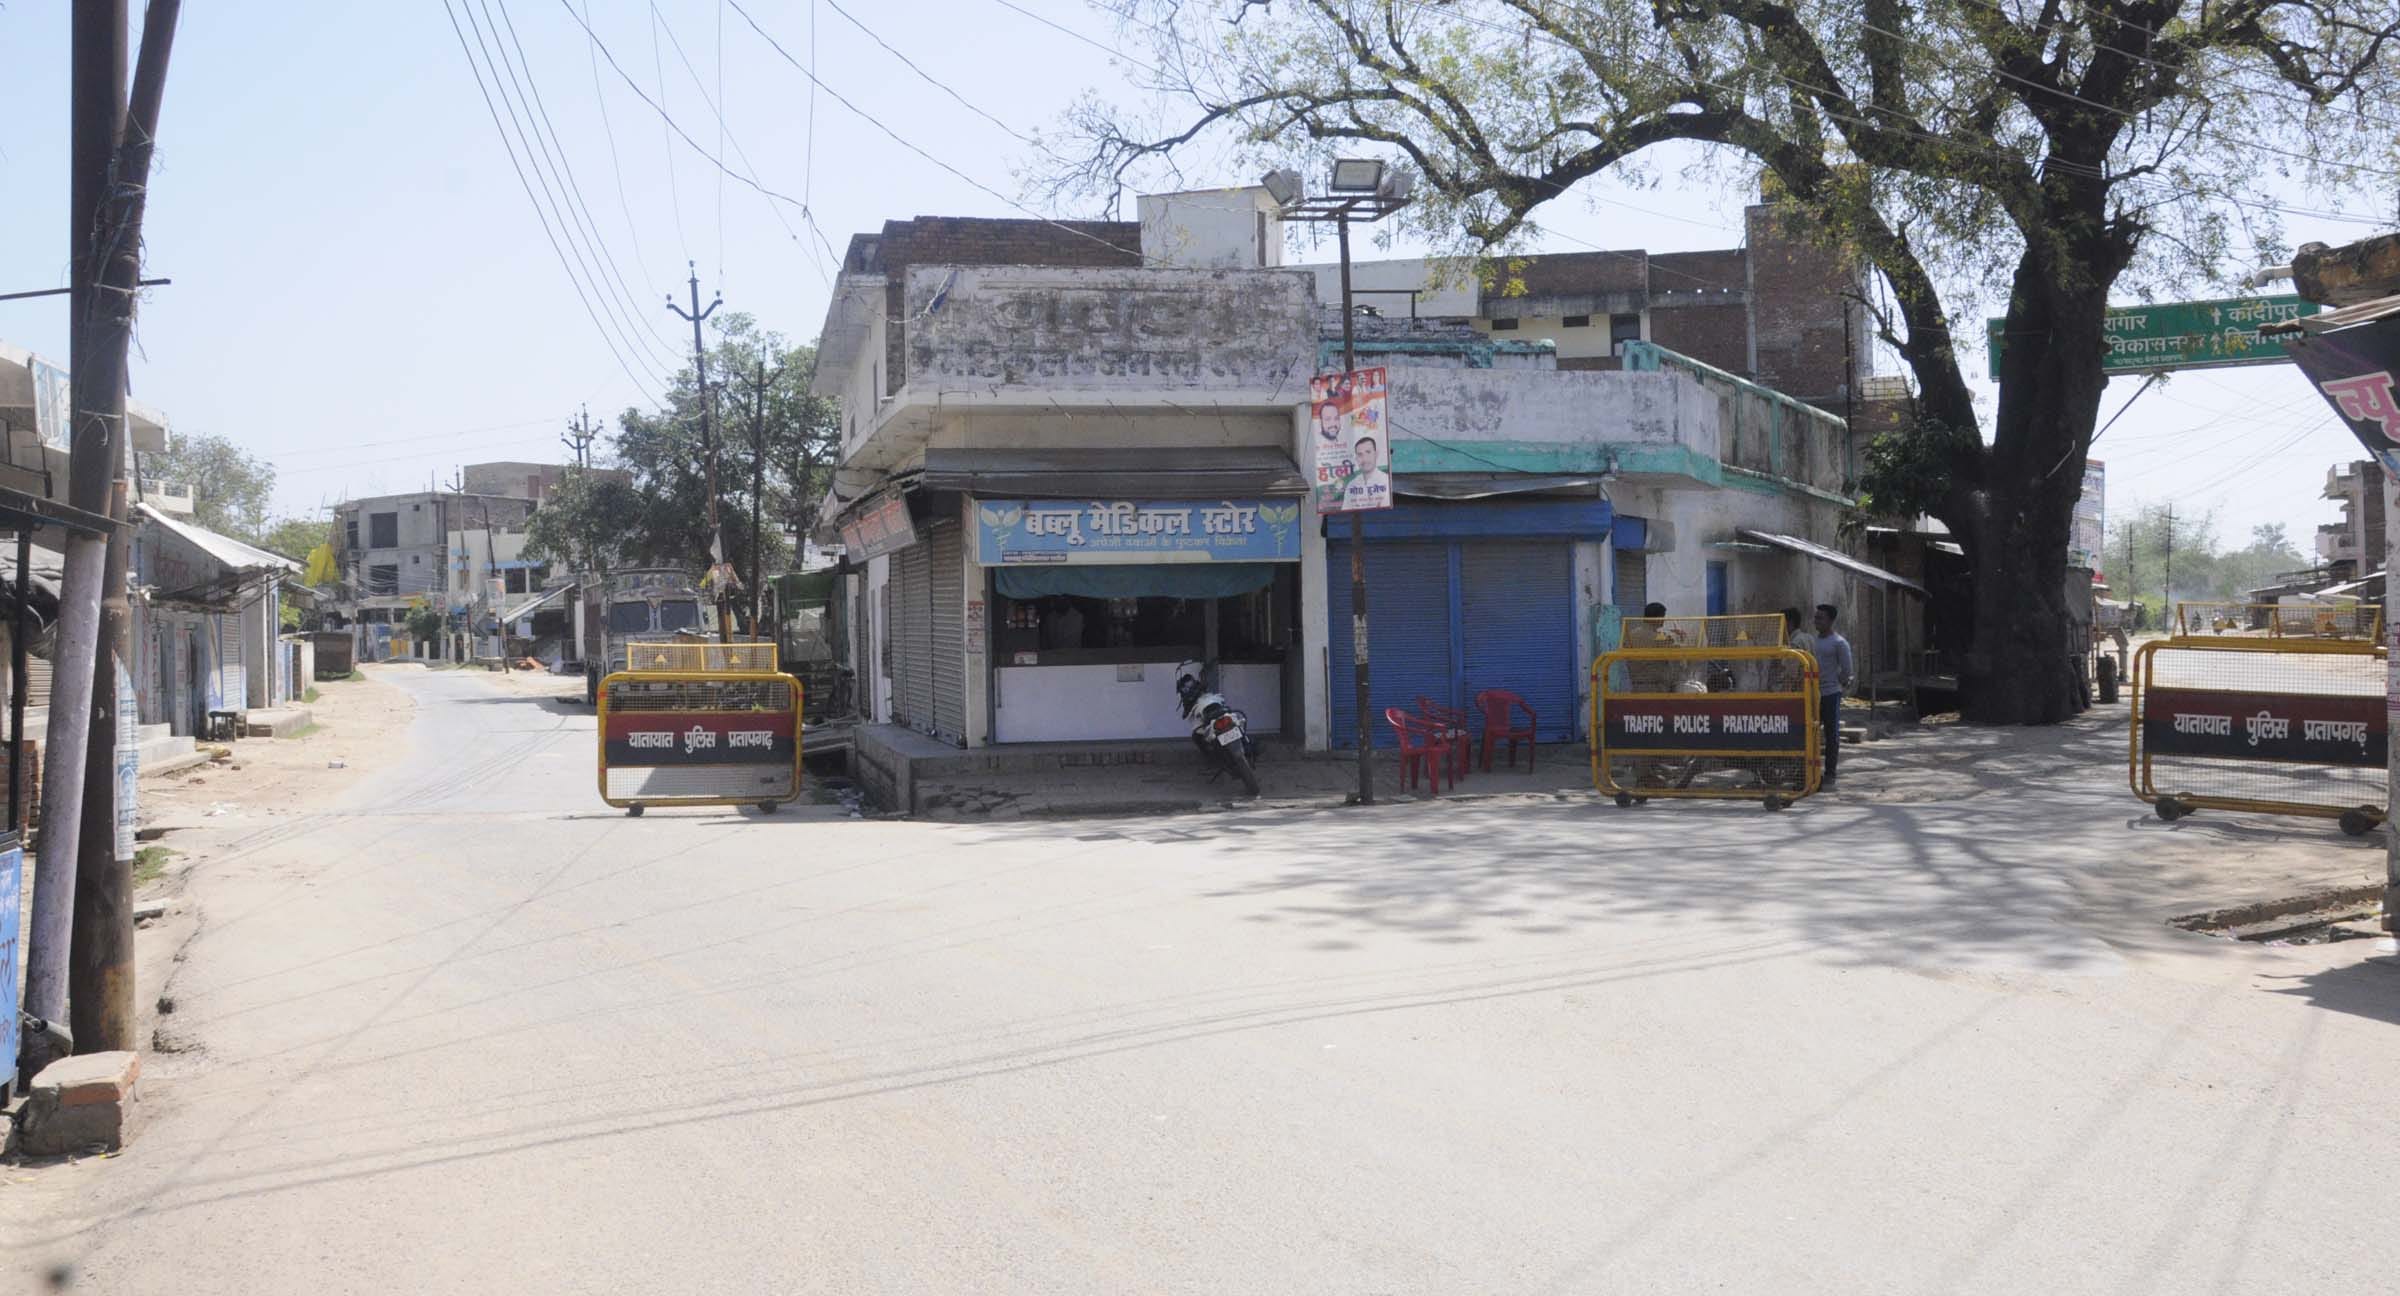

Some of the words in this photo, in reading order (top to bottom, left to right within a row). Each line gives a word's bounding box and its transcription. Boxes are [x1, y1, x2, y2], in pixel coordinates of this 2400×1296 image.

[1025, 507, 1086, 546] बब्लू
[1087, 501, 1193, 536] मेडिकल
[1199, 501, 1258, 535] स्टोर
[628, 731, 674, 748] यातायात
[684, 725, 717, 754] पुलिस
[728, 730, 774, 750] प्रतापगढ़
[1624, 715, 1664, 733] TRAFFIC
[1674, 715, 1711, 733] POLICE
[1723, 715, 1789, 733] PRATAPGARH
[2173, 713, 2232, 736] यातायात
[2246, 711, 2290, 745] पुलिस
[2304, 720, 2368, 748] प्रतापगढ़
